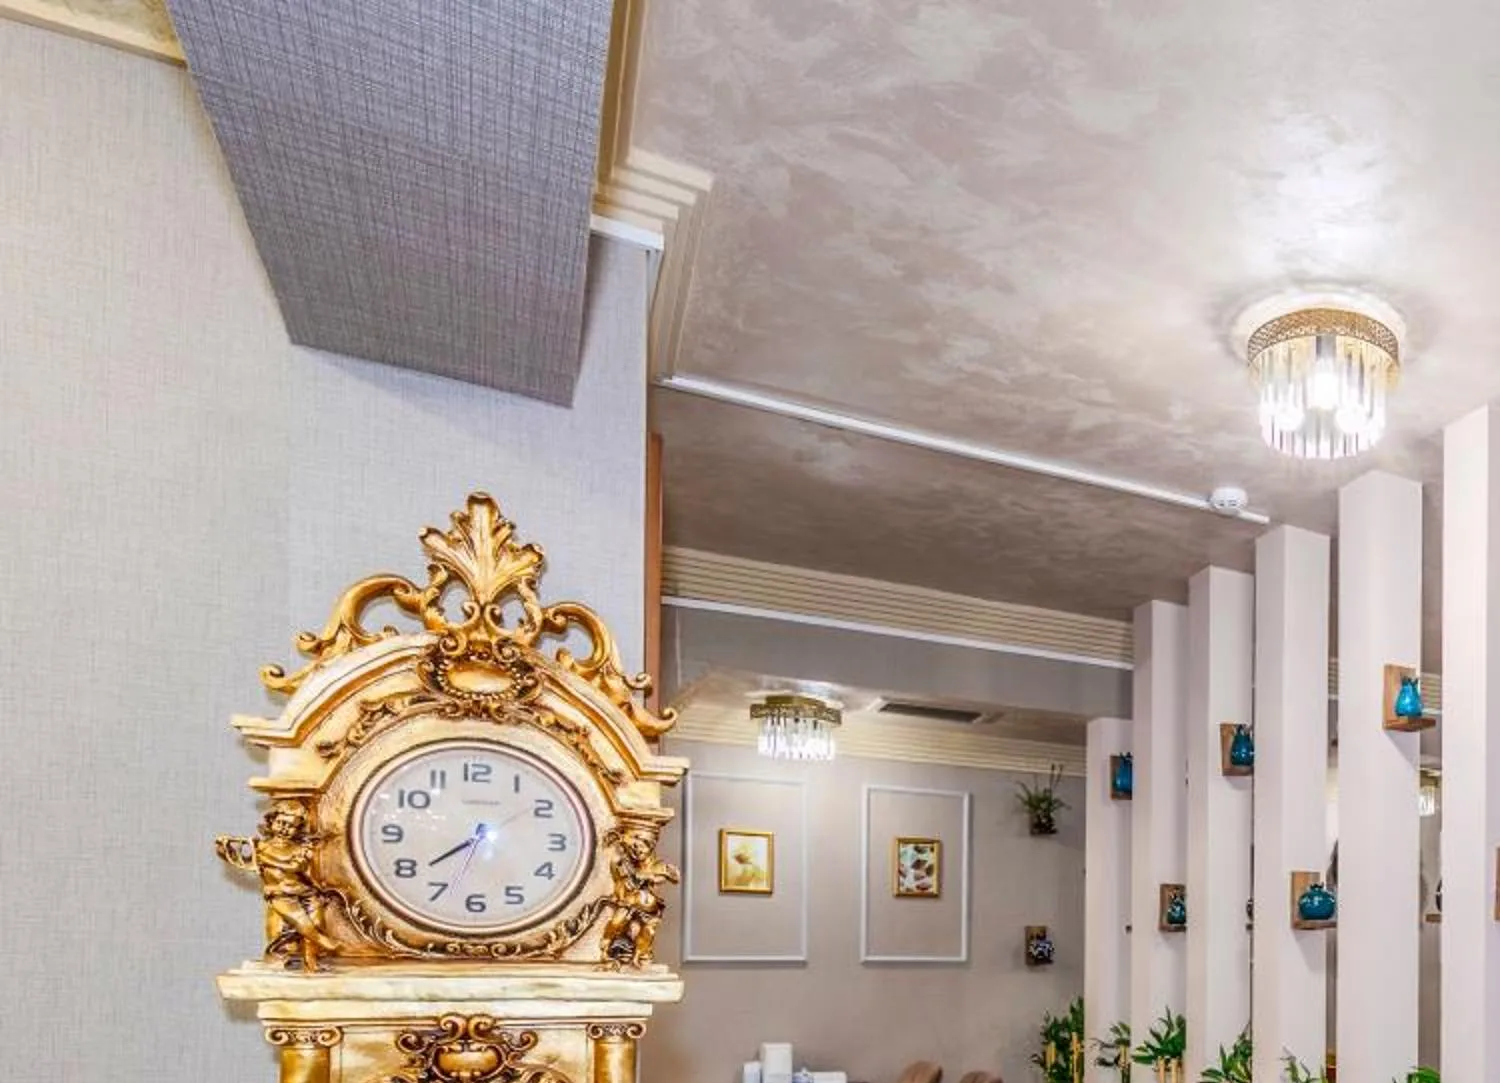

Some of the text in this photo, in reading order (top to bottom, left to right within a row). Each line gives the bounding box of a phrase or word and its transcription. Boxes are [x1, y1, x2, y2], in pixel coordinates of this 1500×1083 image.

[430, 770, 446, 789] 11
[463, 763, 492, 783] 12
[514, 774, 520, 793] 1
[398, 789, 431, 810] 10
[533, 799, 553, 818] 2
[381, 824, 403, 843] 9
[549, 833, 567, 852] 3
[394, 858, 417, 878] 8
[534, 862, 554, 881] 4
[428, 882, 448, 902] 7
[504, 886, 525, 905] 5
[464, 894, 487, 913] 6
